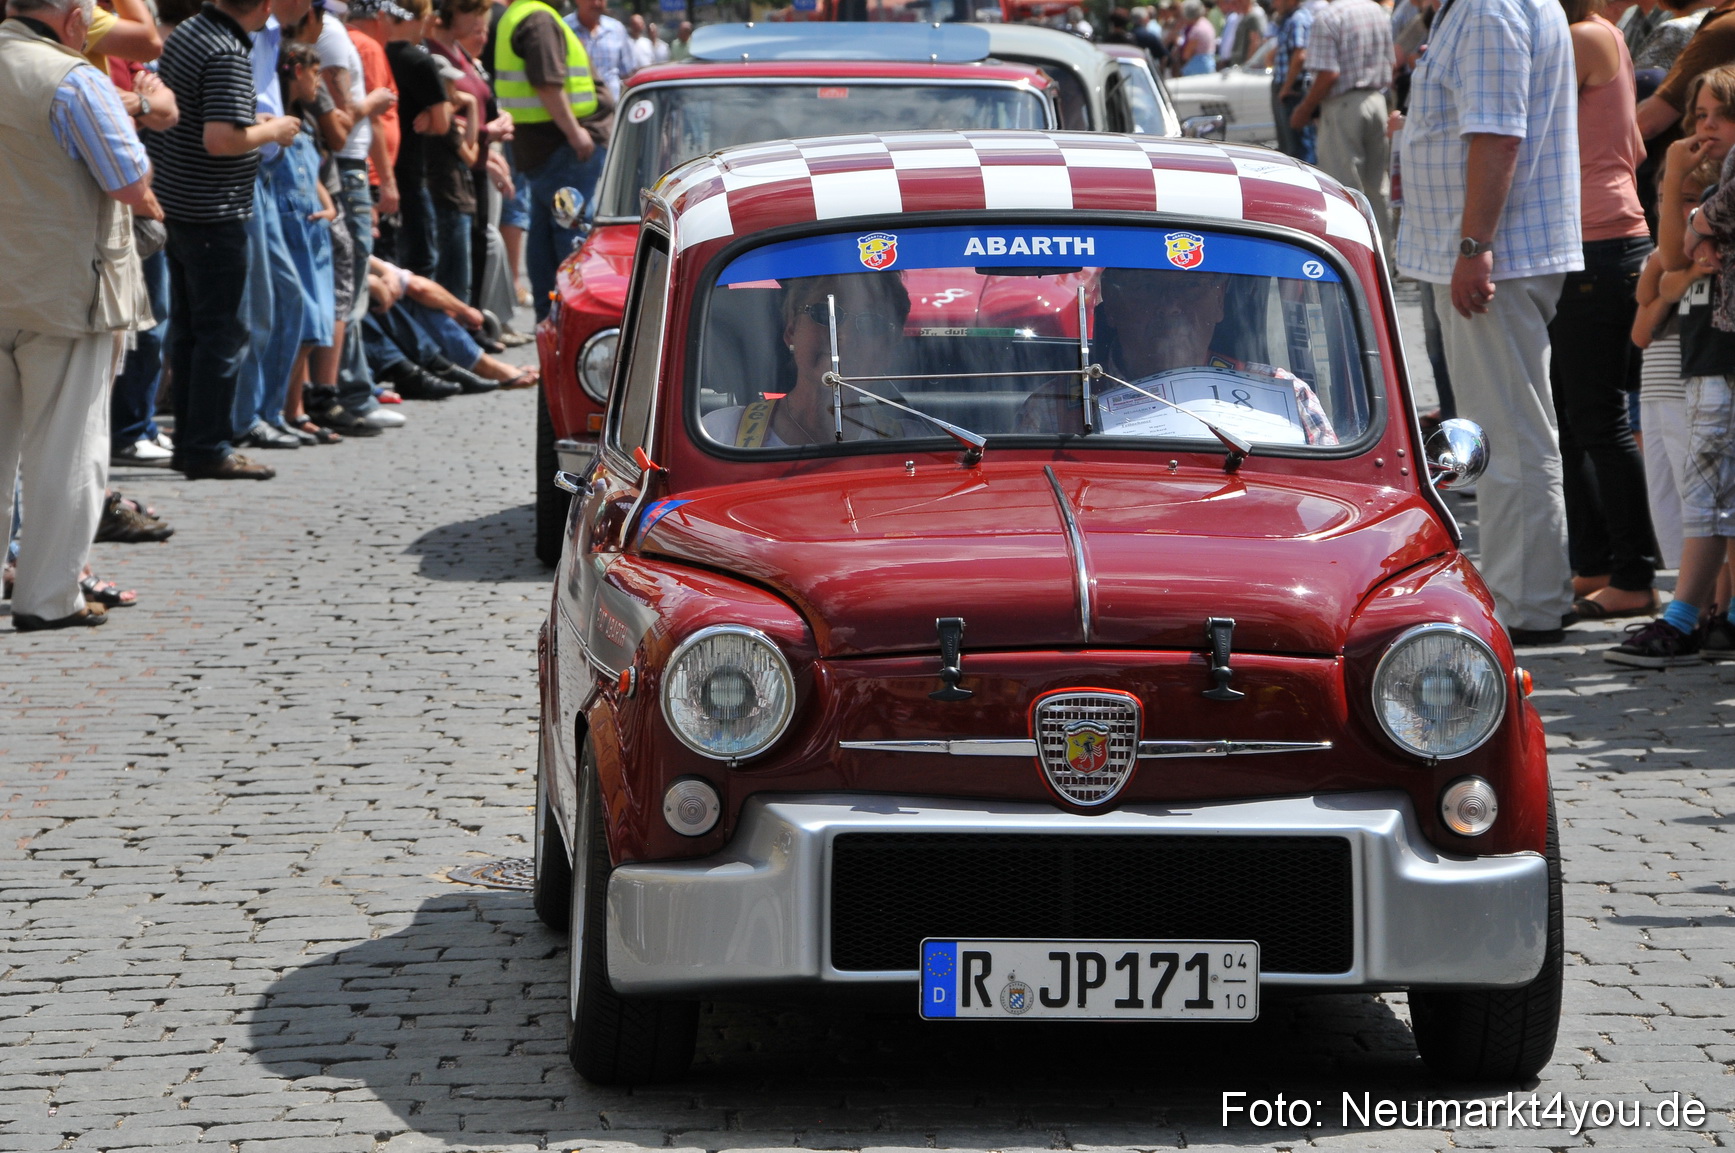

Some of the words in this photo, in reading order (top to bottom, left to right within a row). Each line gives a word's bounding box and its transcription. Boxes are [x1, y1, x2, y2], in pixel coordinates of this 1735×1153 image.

[964, 236, 1096, 256] ABARTH
[1306, 264, 1320, 276] Z
[1208, 384, 1254, 412] 18
[1223, 953, 1247, 969] 04
[933, 987, 946, 1003] D
[961, 951, 993, 1008] R
[1039, 951, 1214, 1009] JP171
[1225, 993, 1247, 1009] 10
